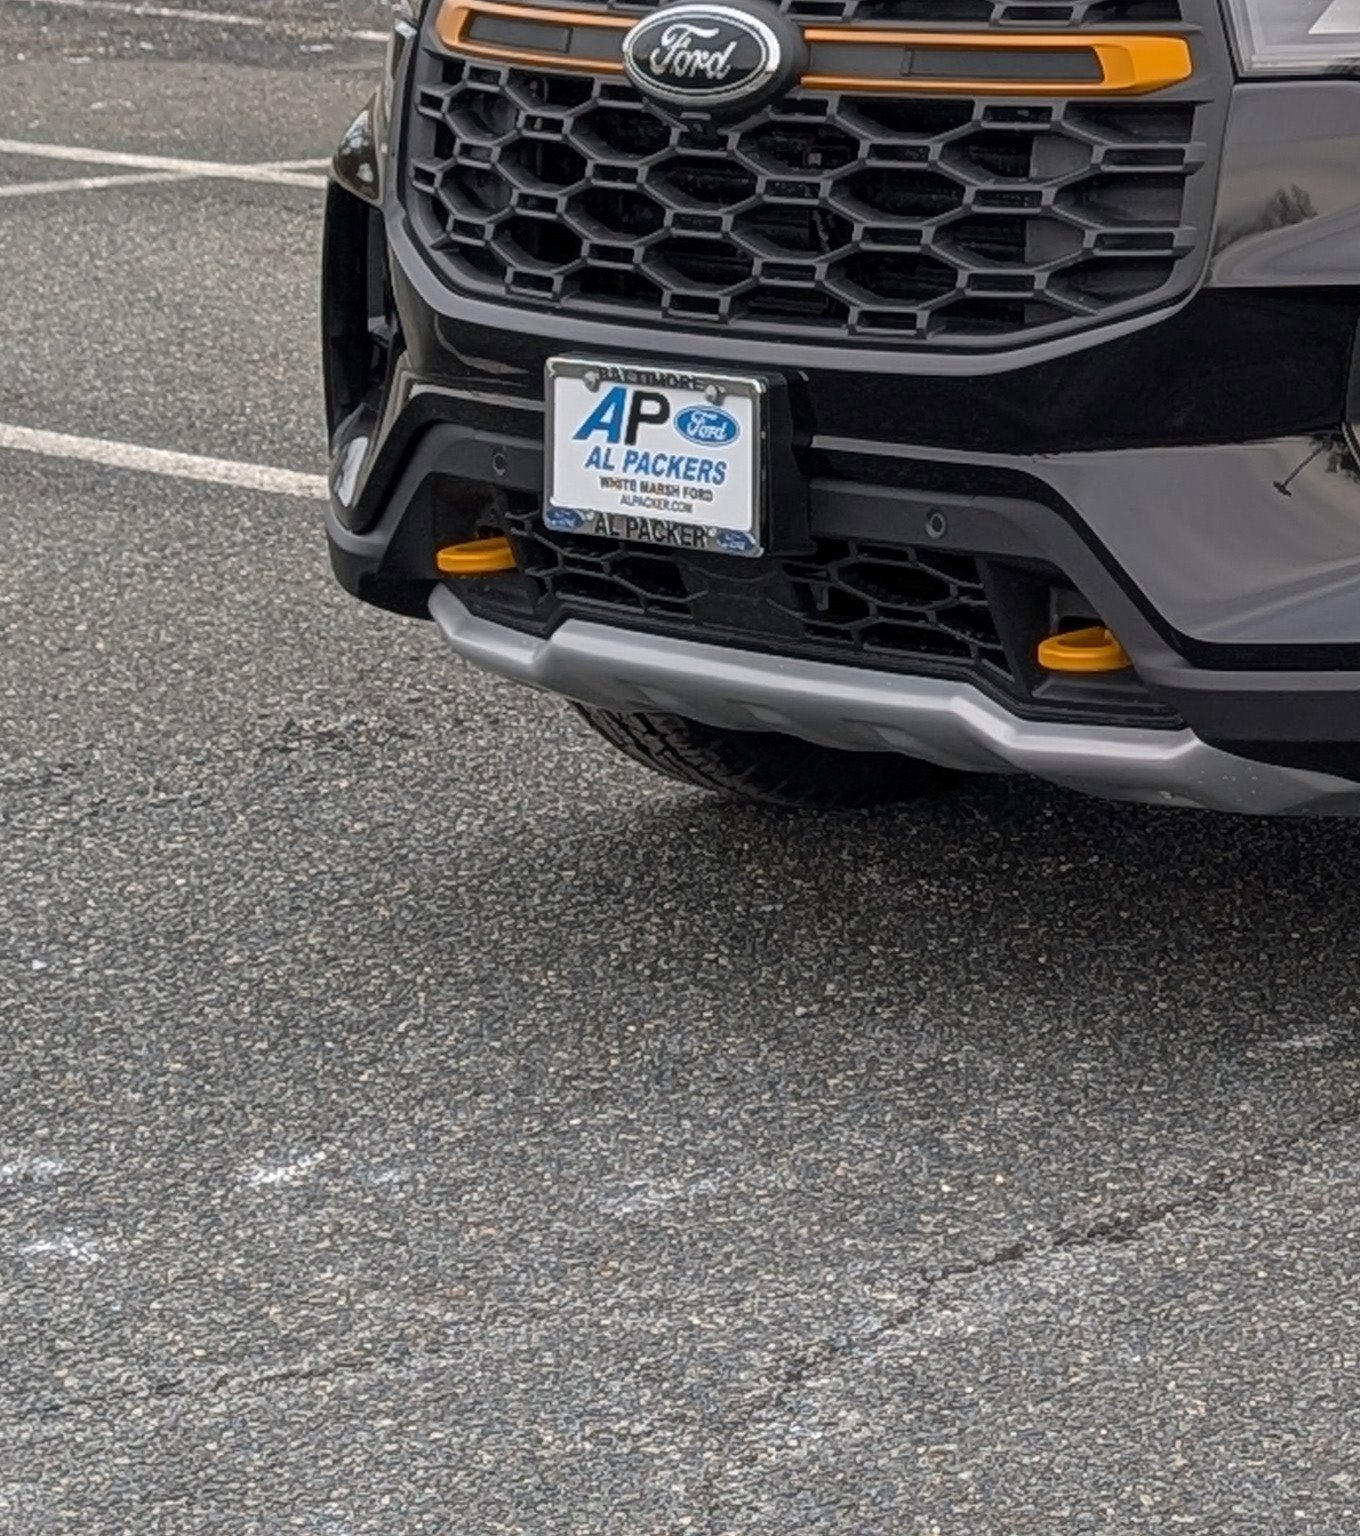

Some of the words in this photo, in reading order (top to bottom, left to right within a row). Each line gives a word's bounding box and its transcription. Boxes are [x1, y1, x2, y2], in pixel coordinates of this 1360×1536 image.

[650, 22, 738, 80] Ford
[599, 366, 705, 392] BALTIMORE
[572, 385, 670, 446] AP
[685, 410, 728, 440] Ford
[584, 445, 615, 472] AL
[622, 450, 728, 486] PACKERS
[600, 475, 637, 493] WHITE
[640, 481, 680, 497] MARSH
[682, 485, 714, 503] FORD
[593, 512, 621, 537] AL
[625, 517, 709, 549] PACKER
